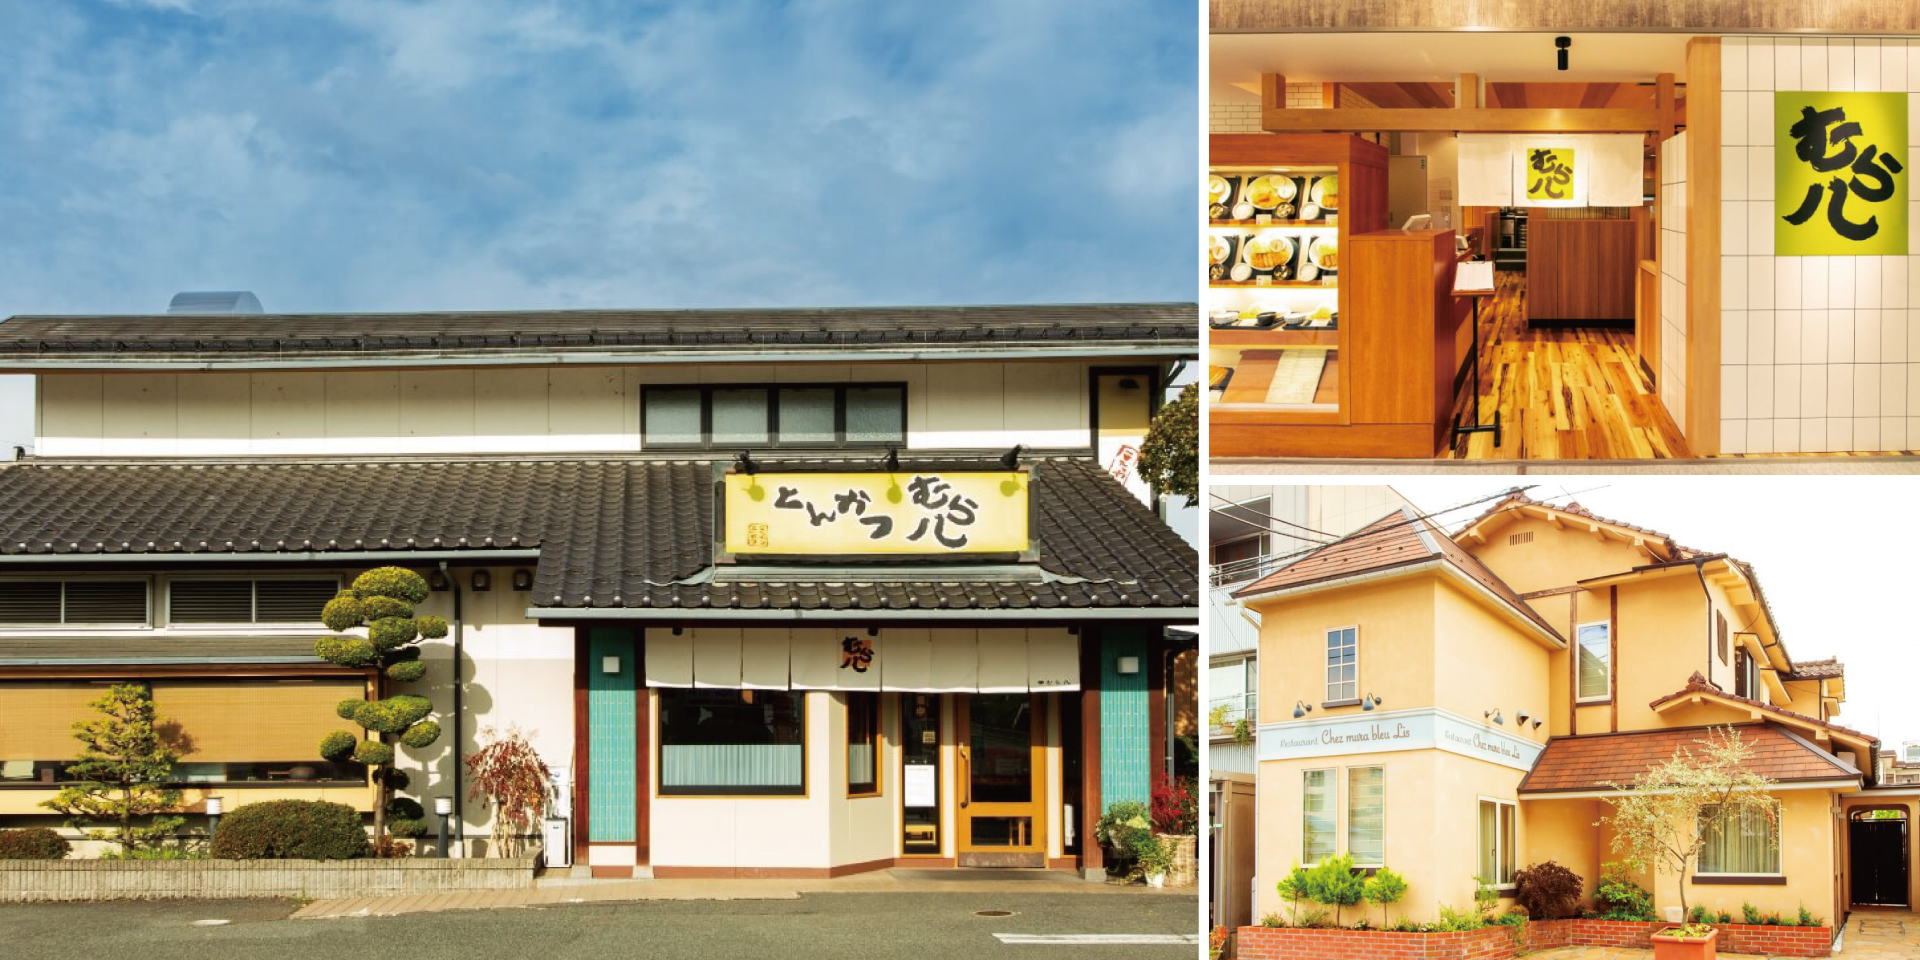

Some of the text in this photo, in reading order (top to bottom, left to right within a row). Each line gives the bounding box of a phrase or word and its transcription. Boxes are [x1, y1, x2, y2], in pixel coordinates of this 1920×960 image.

[1527, 149, 1574, 199] むら八
[1781, 106, 1904, 241] むら八
[774, 476, 980, 548] とんかつ むら八
[1280, 722, 1410, 747] Restaurant Chez mura bleu Lis
[1473, 733, 1487, 751] Chez
